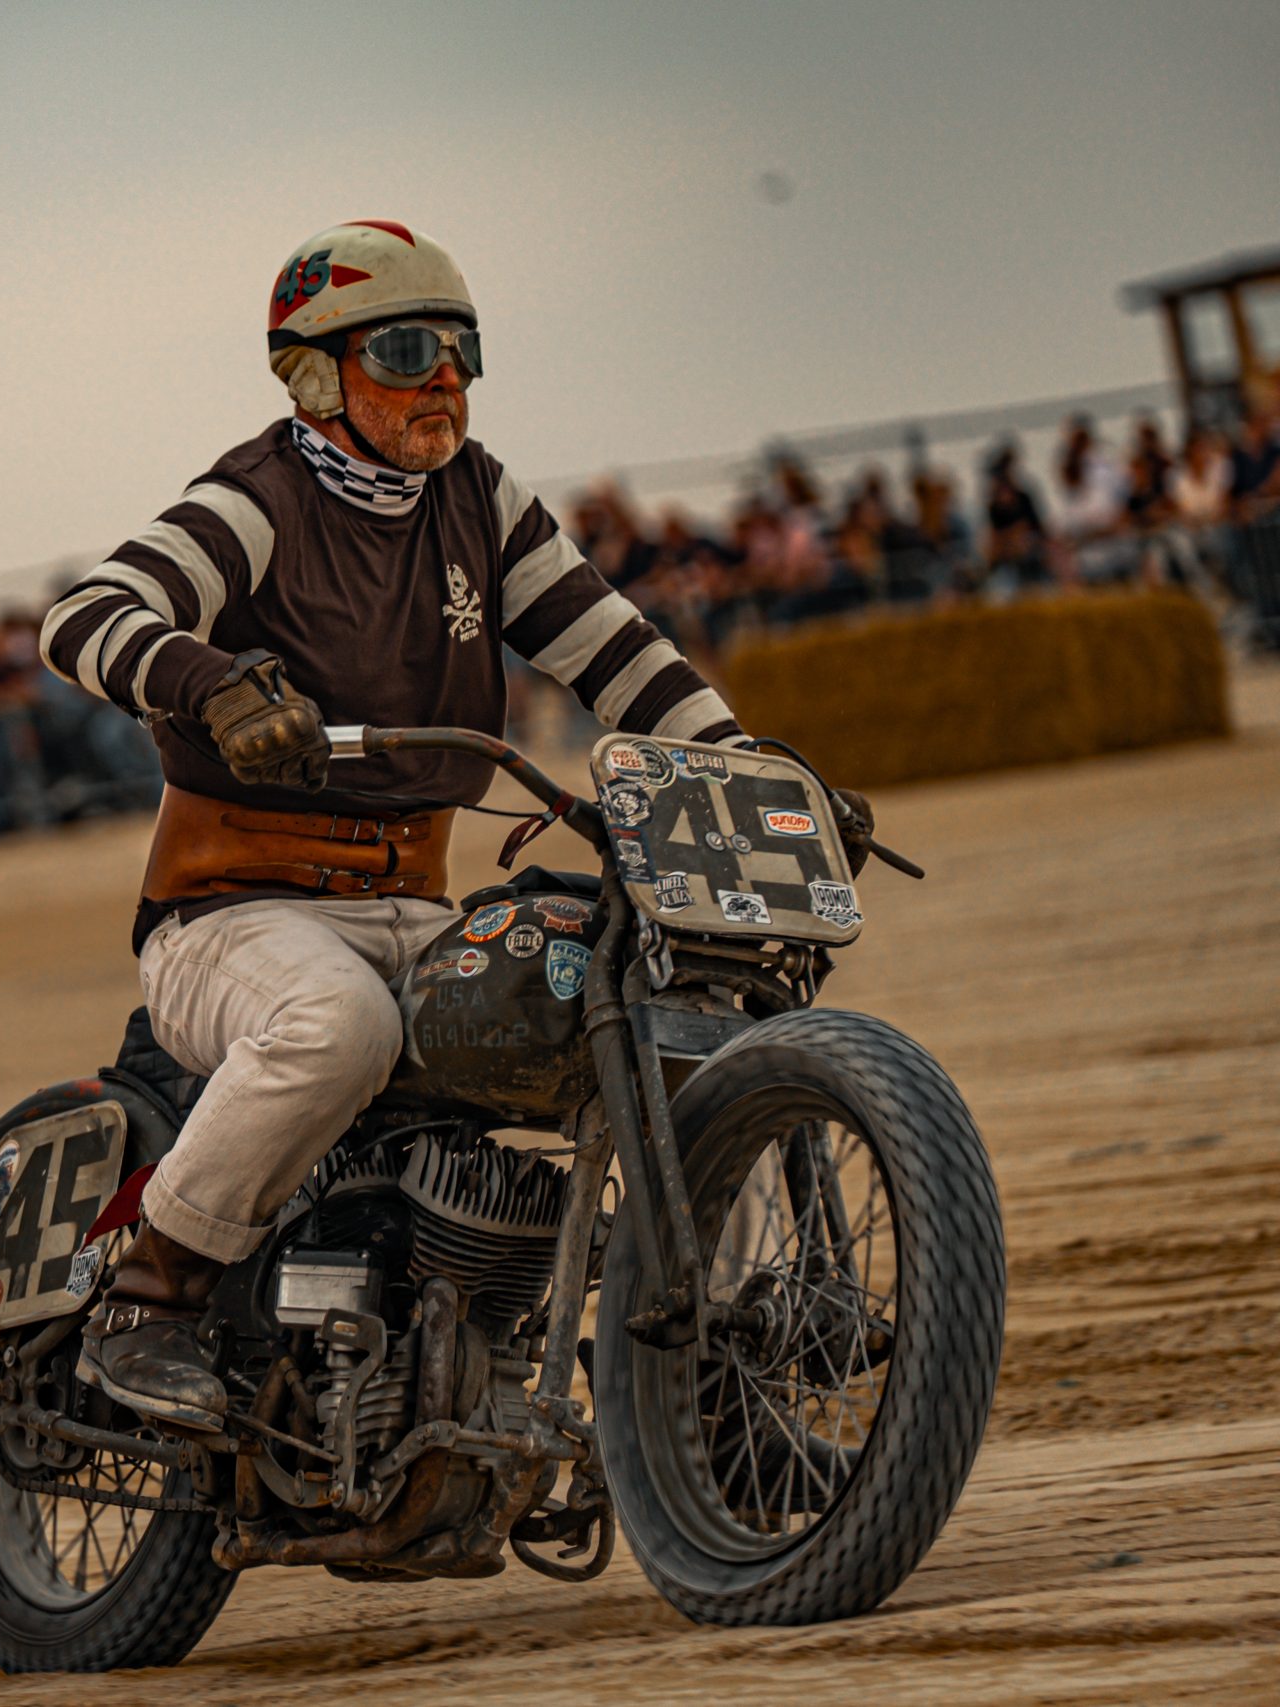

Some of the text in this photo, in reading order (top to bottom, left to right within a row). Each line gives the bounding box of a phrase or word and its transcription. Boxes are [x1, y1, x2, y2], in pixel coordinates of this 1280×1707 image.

[276, 248, 333, 307] 45
[650, 770, 834, 913] 45
[767, 815, 811, 830] SUNDAY
[436, 985, 485, 1010] USA
